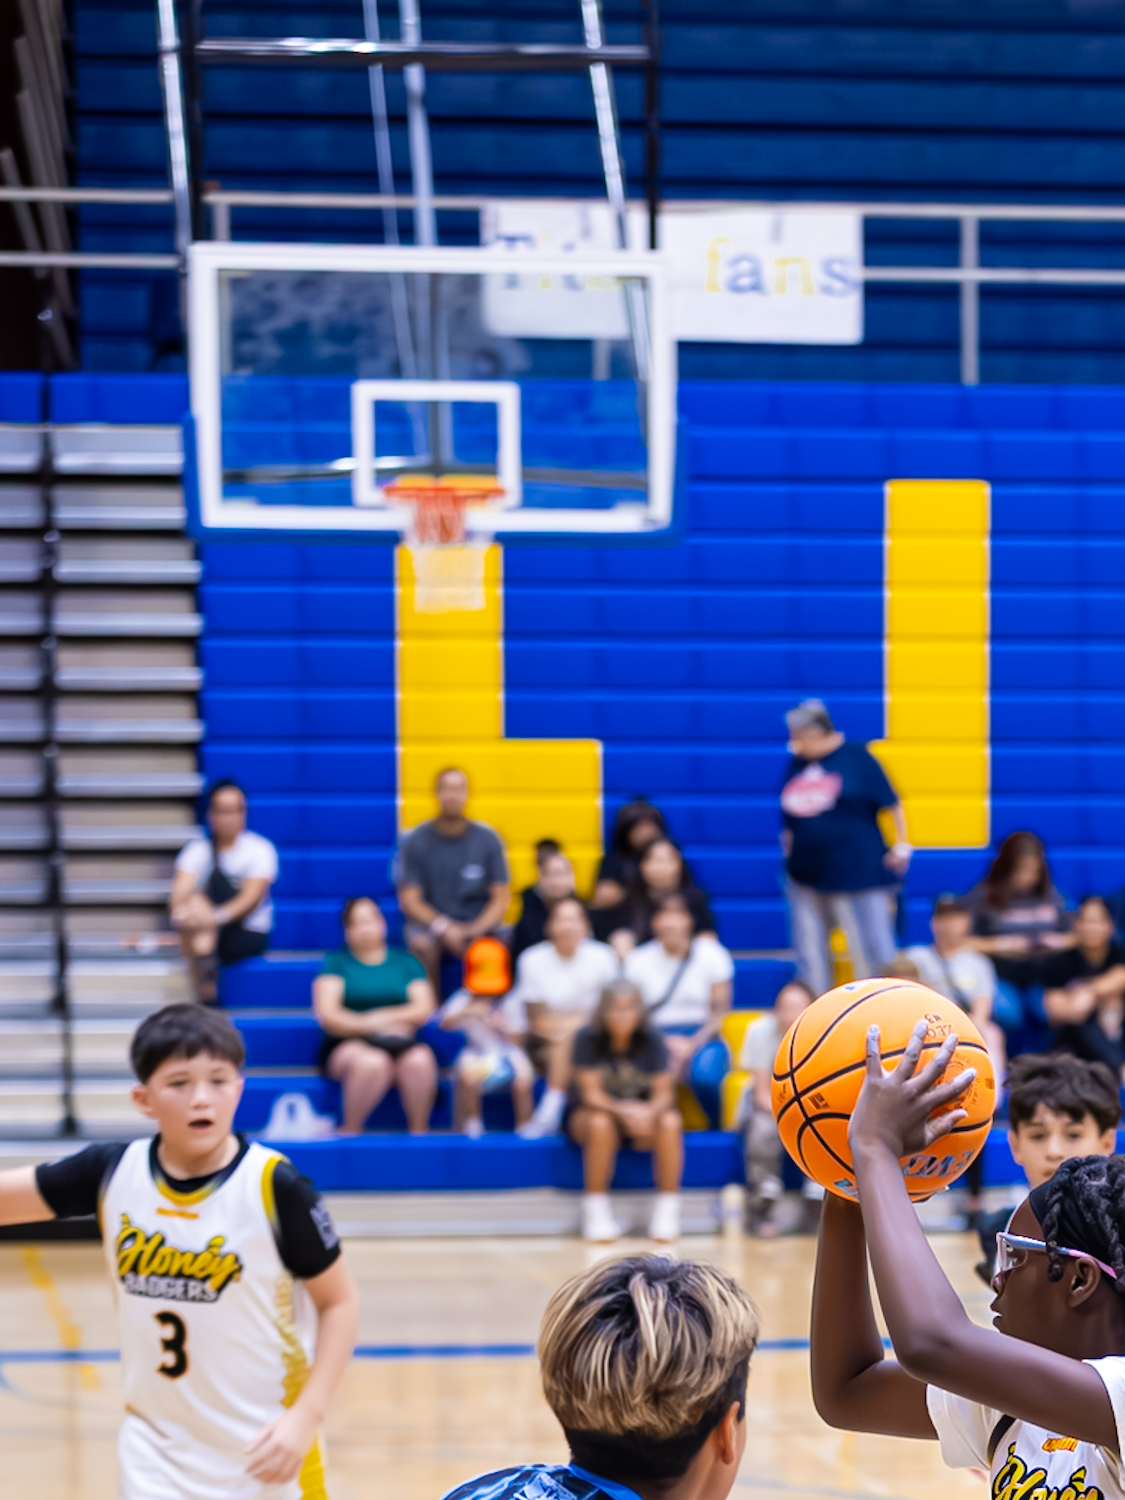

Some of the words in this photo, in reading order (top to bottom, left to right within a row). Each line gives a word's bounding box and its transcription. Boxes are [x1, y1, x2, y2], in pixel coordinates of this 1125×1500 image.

[705, 236, 862, 297] fans
[117, 1214, 242, 1292] Honey
[153, 1310, 190, 1381] 3
